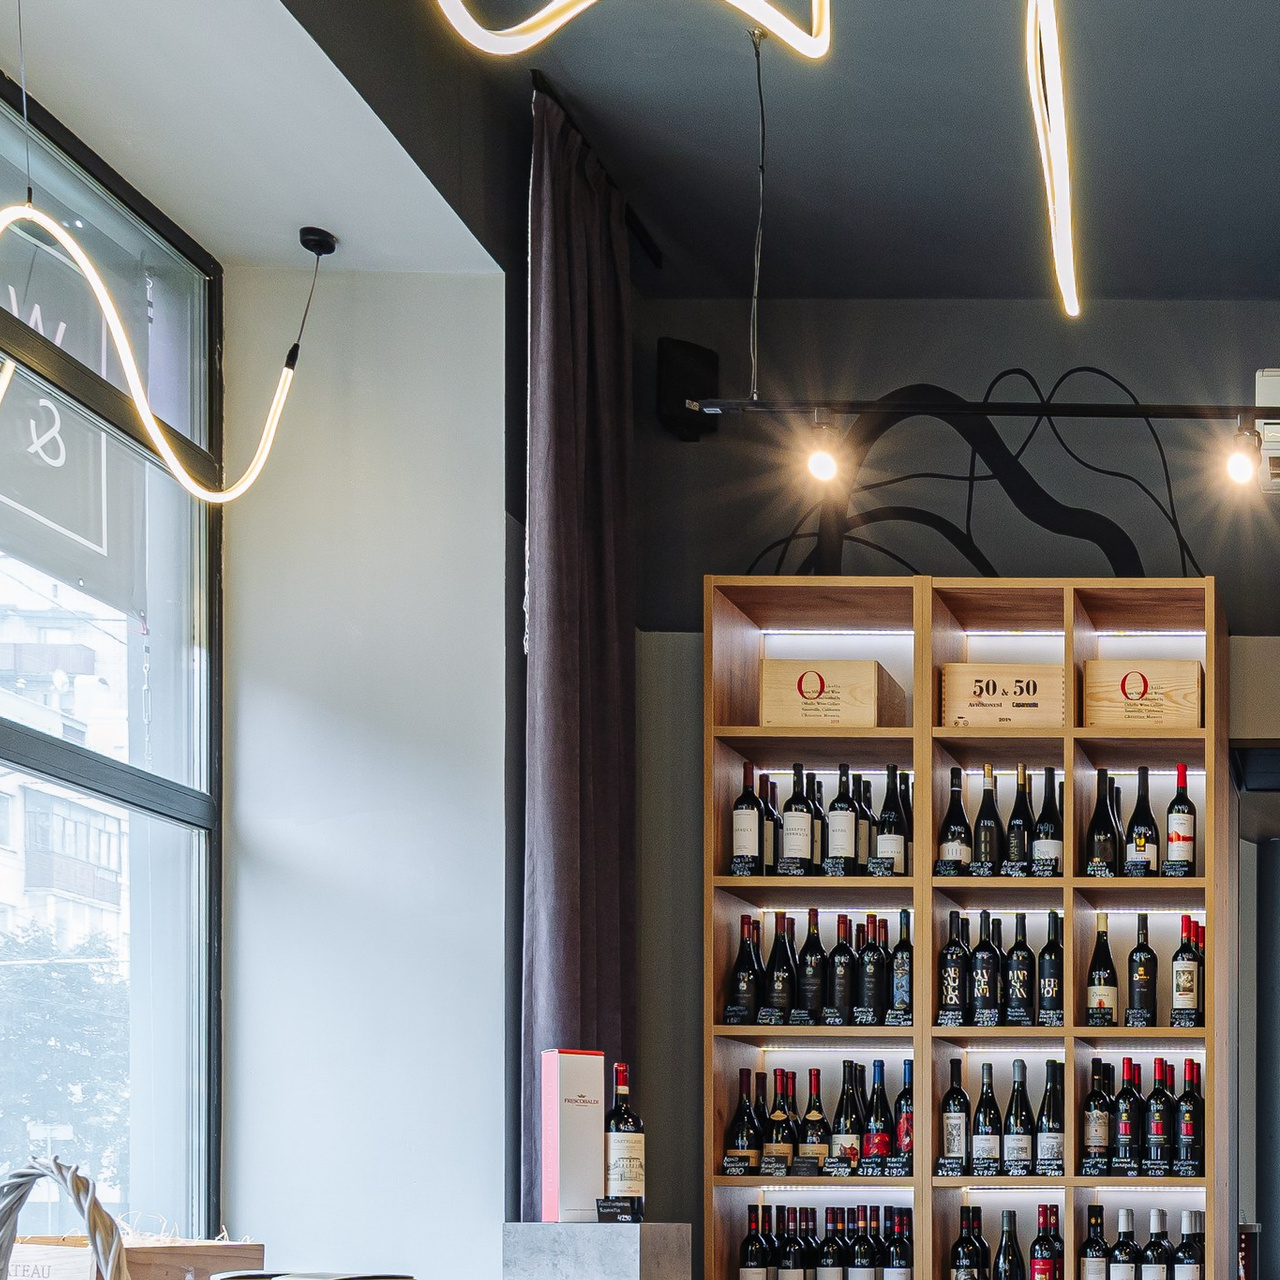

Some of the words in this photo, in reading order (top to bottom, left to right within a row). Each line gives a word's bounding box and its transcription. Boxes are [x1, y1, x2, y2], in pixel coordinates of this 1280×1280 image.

[797, 670, 826, 701] O
[973, 679, 997, 697] 50
[1001, 688, 1009, 696] &
[1013, 679, 1038, 697] 50
[1120, 670, 1149, 701] O
